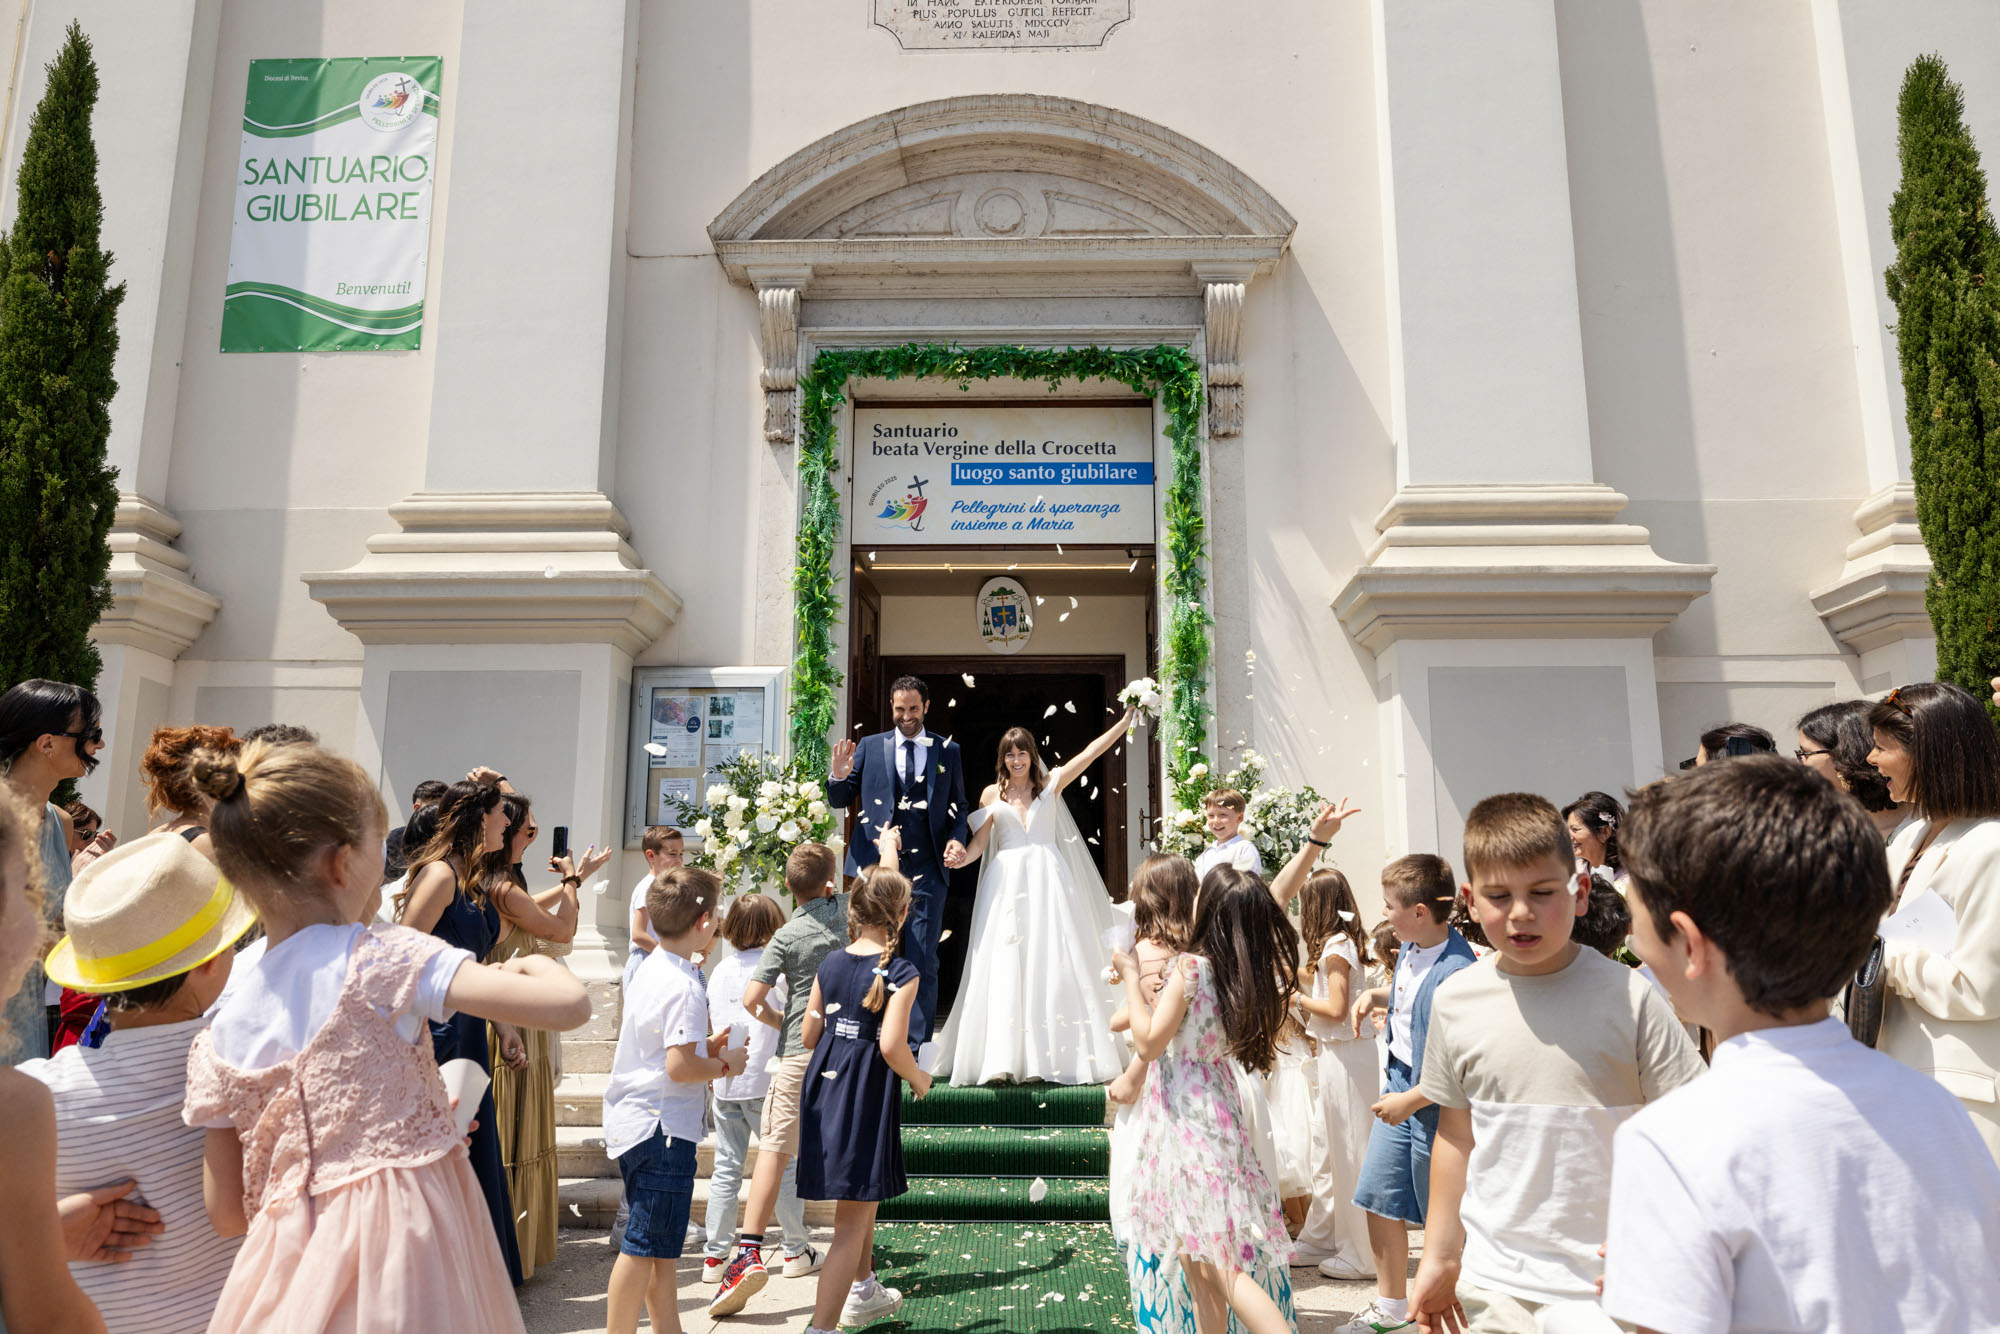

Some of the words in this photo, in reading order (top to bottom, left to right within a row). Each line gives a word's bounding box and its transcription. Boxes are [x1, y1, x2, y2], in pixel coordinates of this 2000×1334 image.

[913, 9, 937, 19] PIUS
[947, 9, 997, 18] POPULUS
[971, 20, 1013, 29] SALUTIS
[1025, 19, 1070, 28] MDCCCIV
[972, 30, 1021, 39] KALENDAS
[243, 154, 429, 186] SANTUARIO
[246, 191, 420, 222] GIUBILARE
[336, 281, 412, 296] Benvenuti!
[873, 423, 958, 438] Santuario
[872, 442, 919, 456] beata
[923, 441, 989, 460] Vergine
[994, 440, 1036, 456] della
[1042, 441, 1117, 455] Crocetta
[955, 464, 1003, 484] luogo
[1009, 466, 1056, 480] santo
[1061, 464, 1138, 484] giubilare
[951, 500, 1026, 519] Pellegrini
[1029, 500, 1046, 514] di
[1049, 502, 1121, 518] speranza
[951, 518, 1008, 531] insieme
[1012, 521, 1024, 531] a
[1026, 517, 1075, 531] Maria
